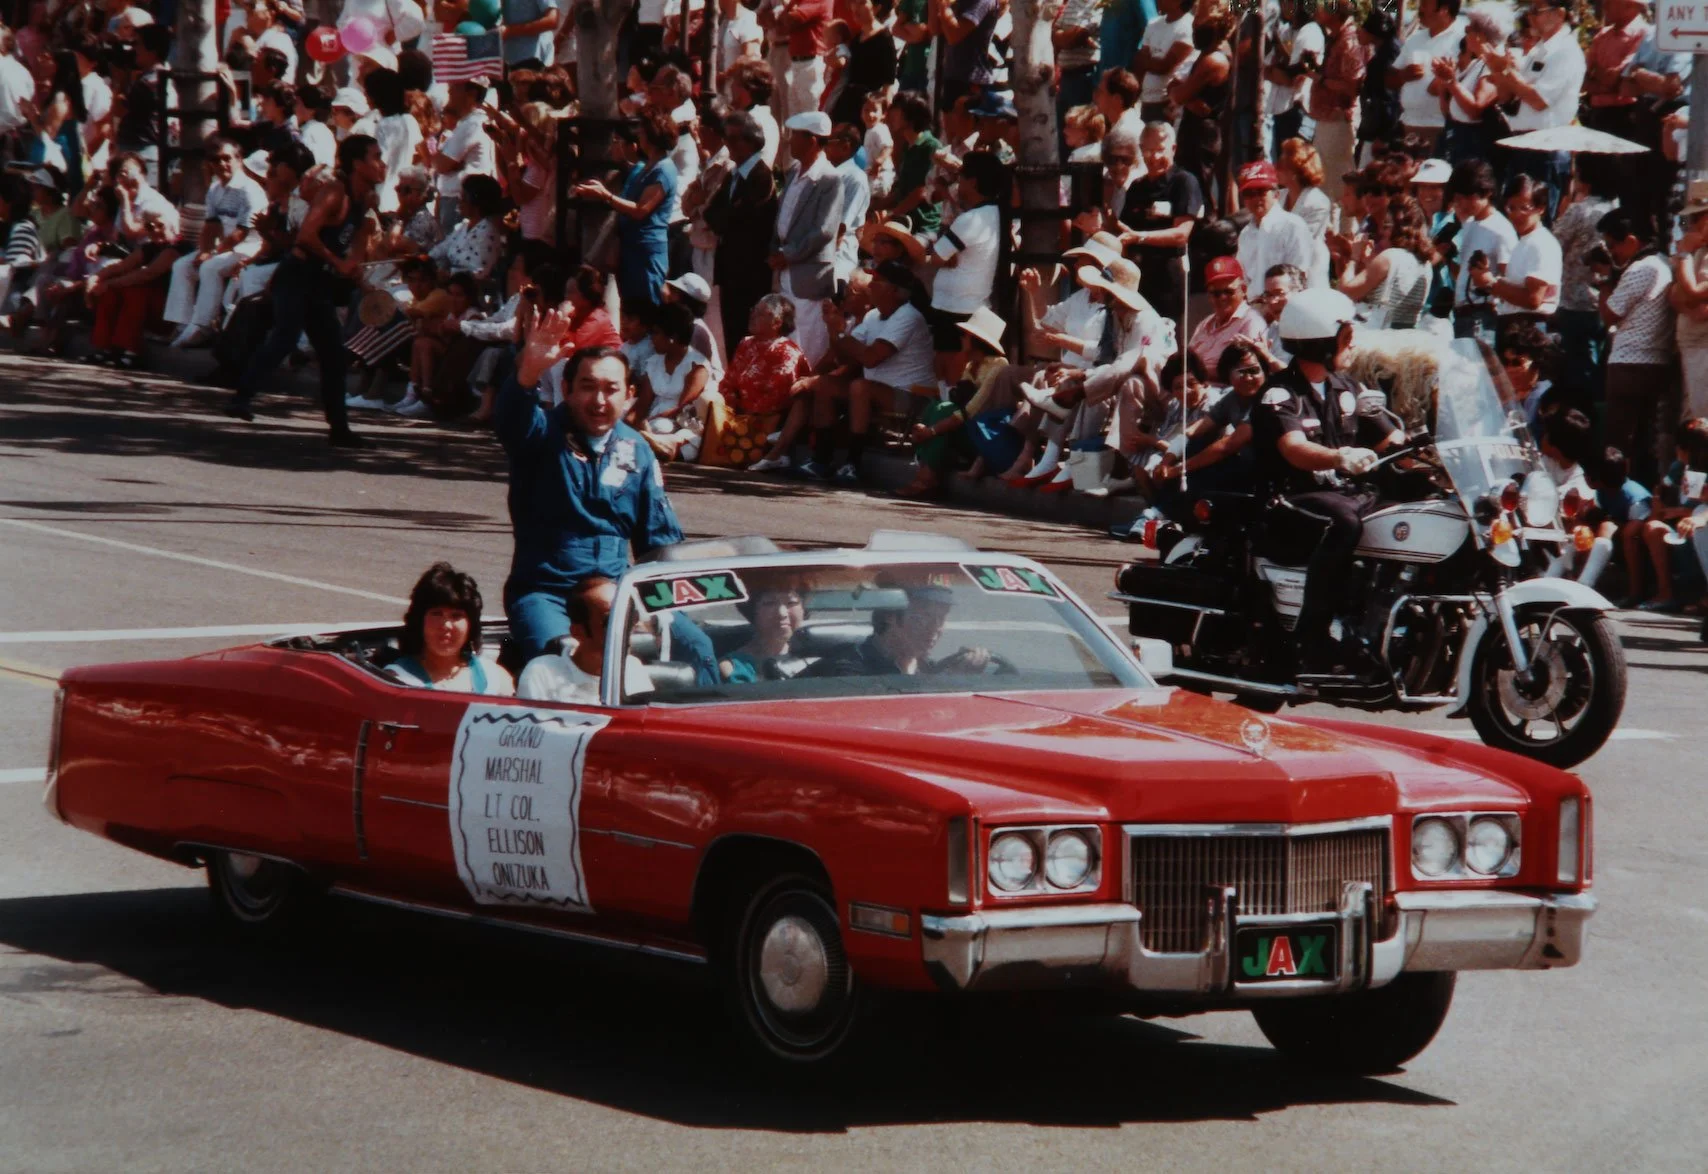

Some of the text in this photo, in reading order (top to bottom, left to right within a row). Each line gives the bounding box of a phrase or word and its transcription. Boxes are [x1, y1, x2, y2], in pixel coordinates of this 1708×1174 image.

[1667, 4, 1696, 21] ANY
[644, 576, 737, 607] JAX
[978, 567, 1055, 595] JAX
[499, 724, 545, 749] GRAND
[485, 756, 544, 785] MARSHAL
[484, 793, 541, 822] LT COL.
[487, 827, 545, 856] ELLISON
[492, 862, 550, 890] ONIZUKA
[1242, 935, 1328, 977] JAX
